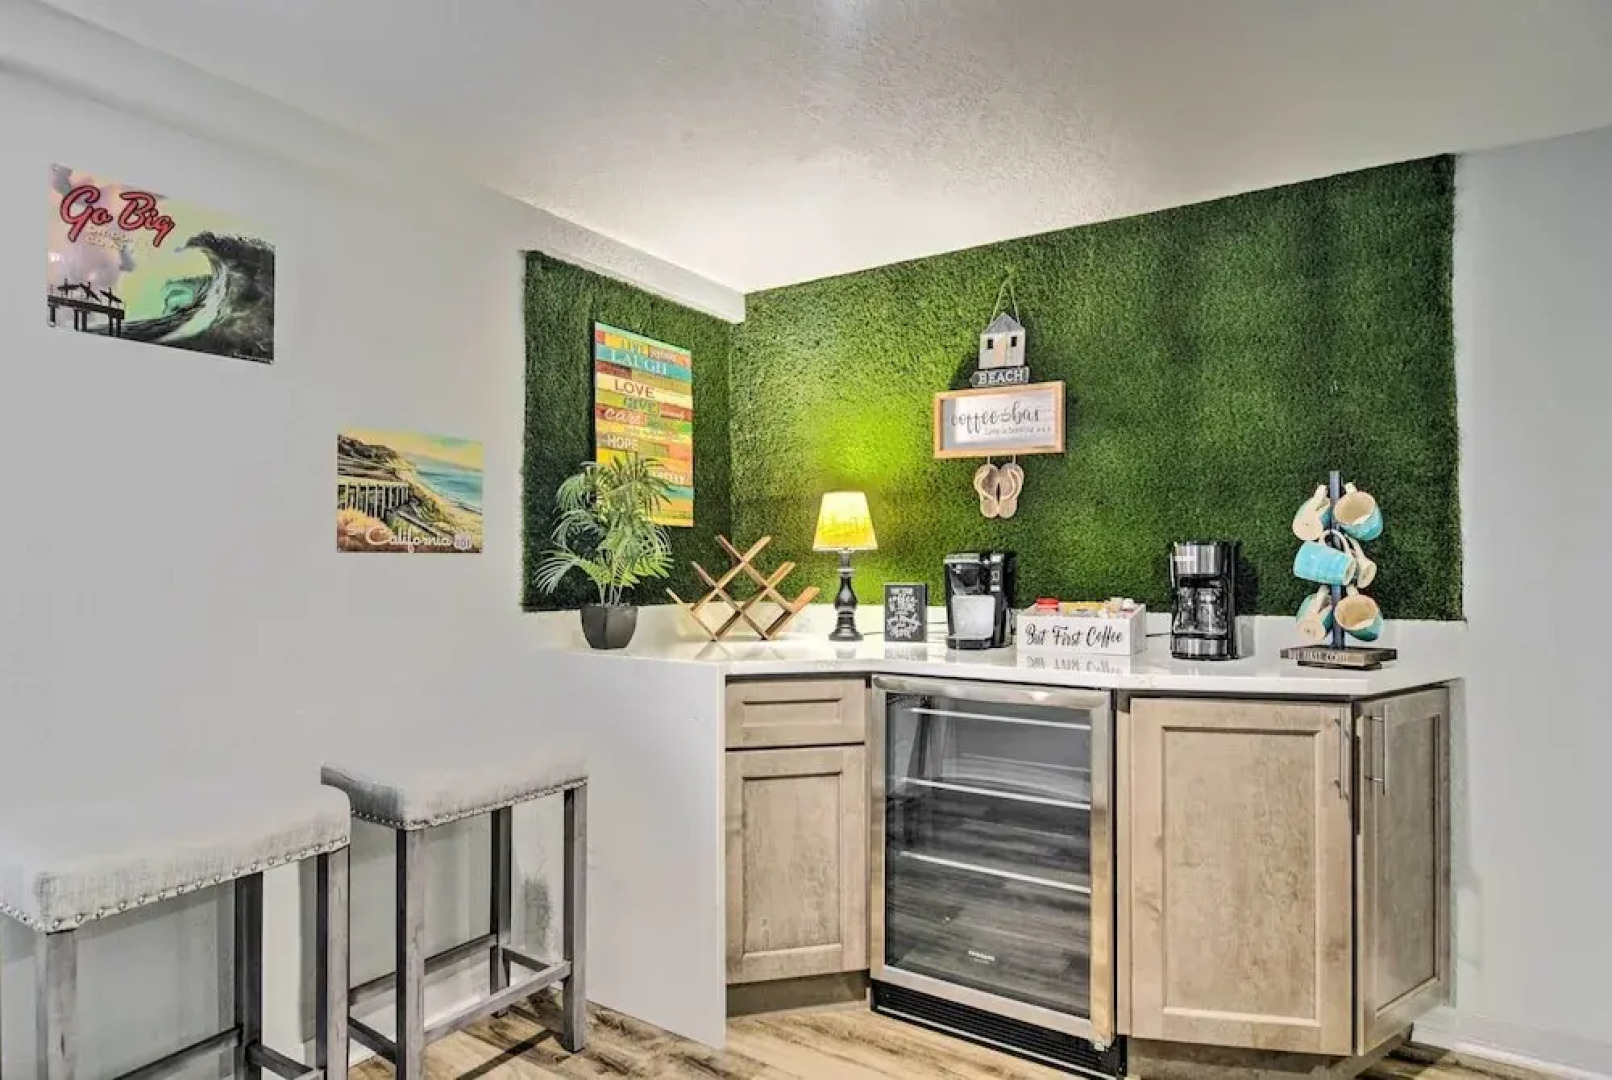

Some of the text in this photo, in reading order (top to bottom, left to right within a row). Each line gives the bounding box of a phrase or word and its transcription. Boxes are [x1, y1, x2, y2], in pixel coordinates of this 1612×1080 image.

[60, 184, 113, 242] Go
[117, 191, 176, 248] Big
[610, 349, 667, 375] LAUGH
[613, 379, 655, 399] LOVE
[978, 369, 1023, 385] BEACH
[950, 400, 1040, 434] coffee bar
[607, 434, 638, 451] HOPE
[365, 525, 453, 553] California
[1025, 623, 1123, 649] But First Coffee
